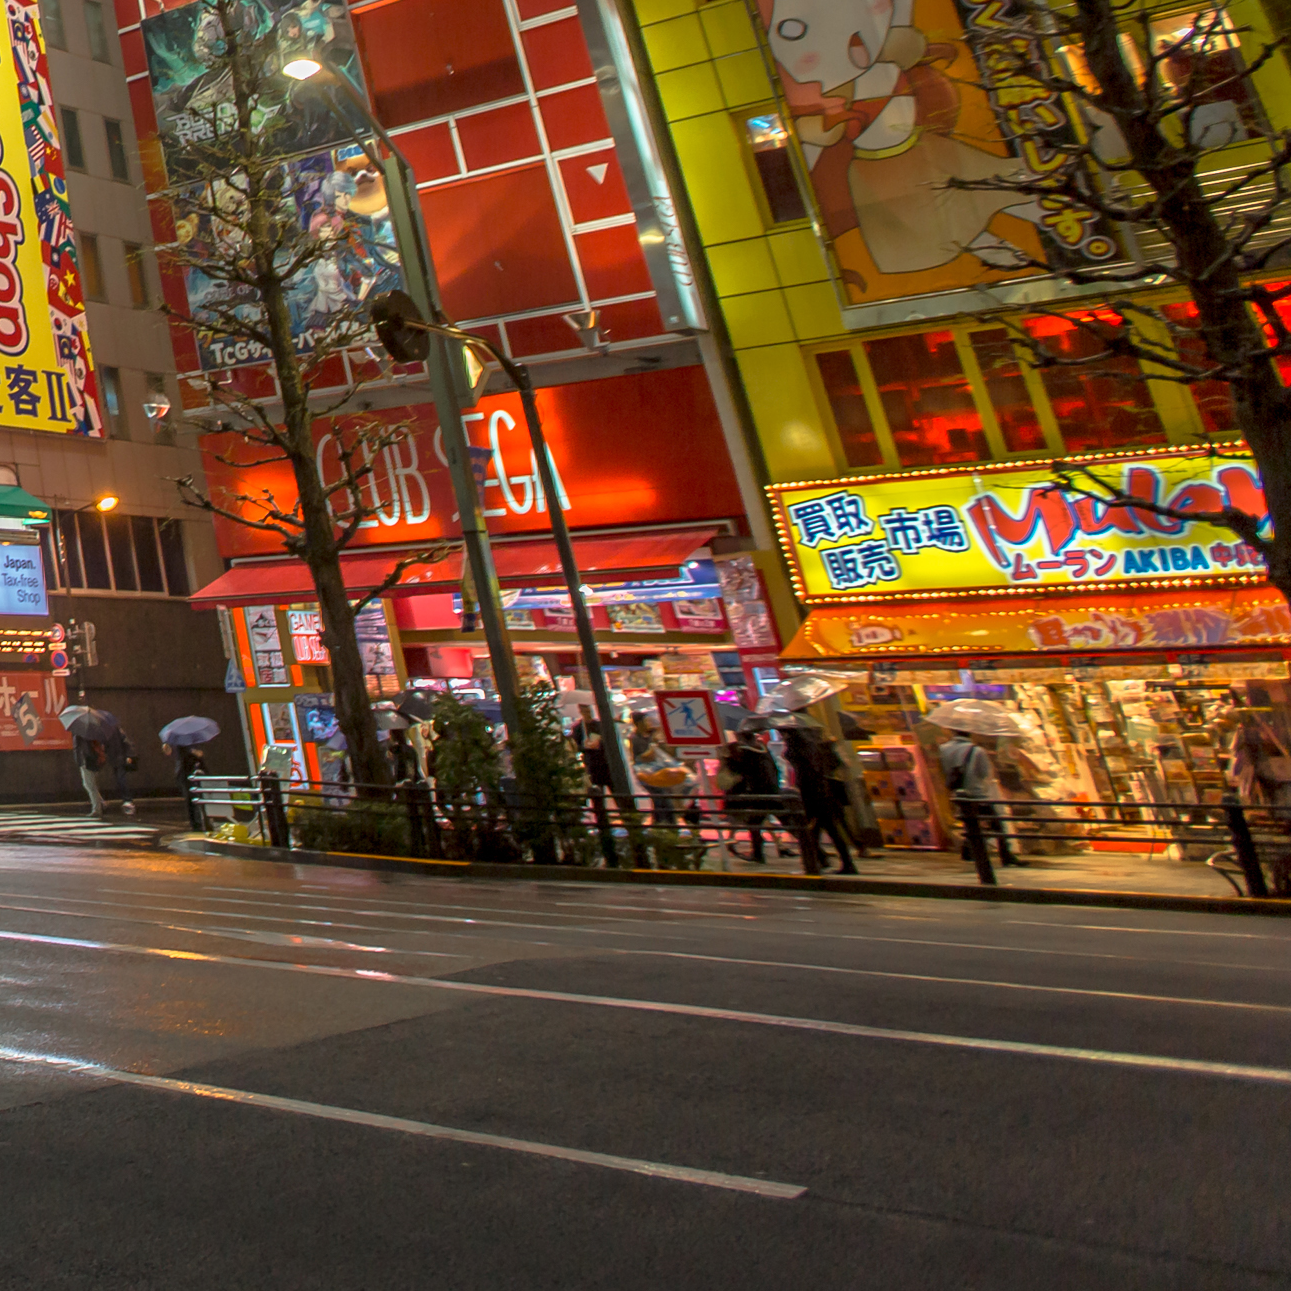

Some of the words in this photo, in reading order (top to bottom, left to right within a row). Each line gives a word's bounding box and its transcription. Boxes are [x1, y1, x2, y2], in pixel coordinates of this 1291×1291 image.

[316, 424, 431, 529] CLUB
[792, 496, 867, 540] 買取
[880, 509, 965, 553] 市場
[2, 572, 39, 588] Tax-free
[3, 556, 37, 571] Japan.
[825, 542, 899, 587] 販売
[1012, 549, 1116, 580] ムーラン
[1123, 546, 1209, 573] AKIBA
[17, 589, 41, 605] Shop
